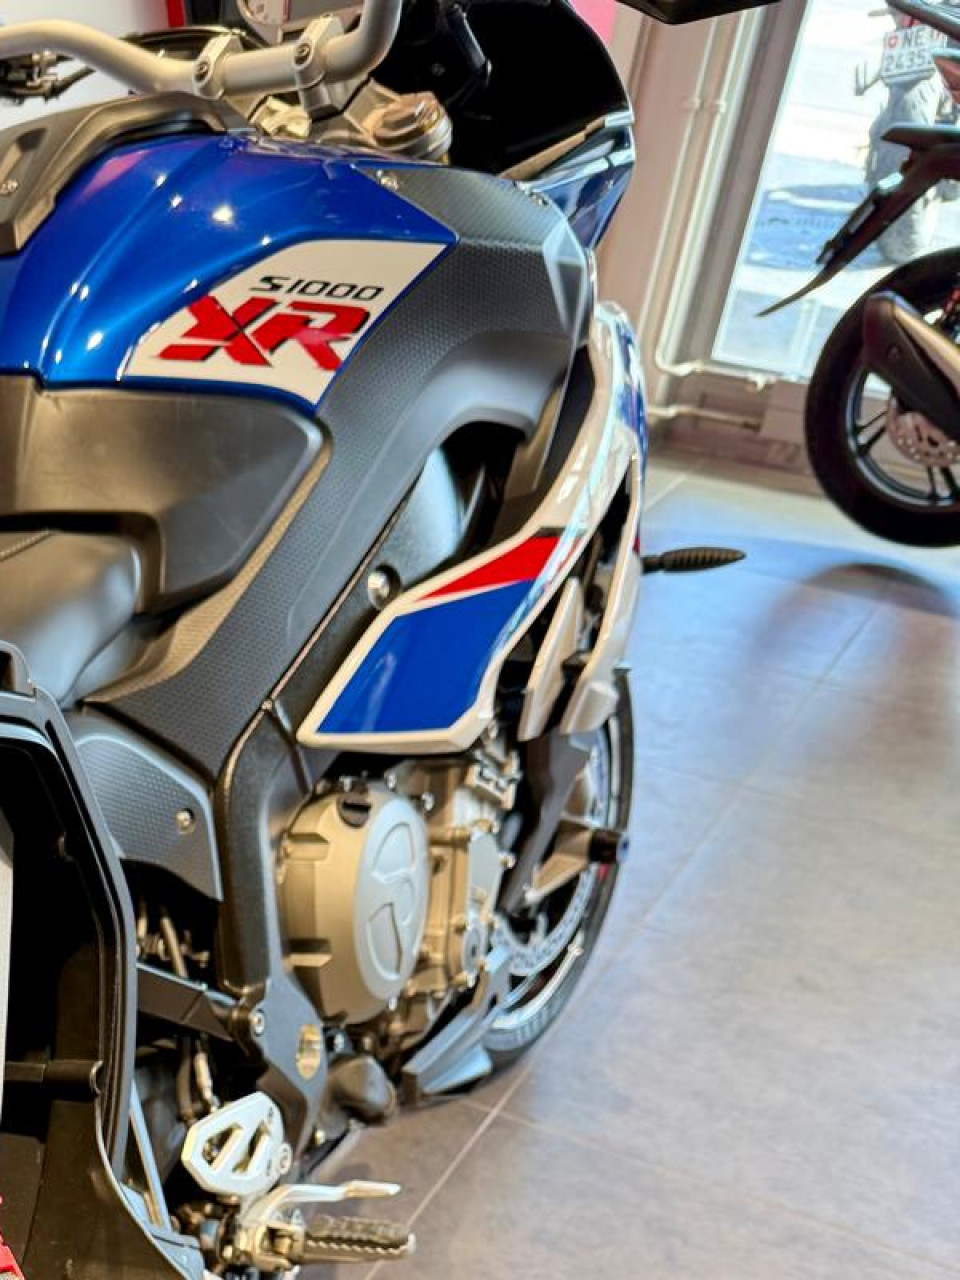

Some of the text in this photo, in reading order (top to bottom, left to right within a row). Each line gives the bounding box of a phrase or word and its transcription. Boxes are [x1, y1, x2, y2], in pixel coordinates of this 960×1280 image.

[884, 49, 933, 72] 2435
[250, 275, 384, 300] S1000
[157, 294, 371, 371] XR
